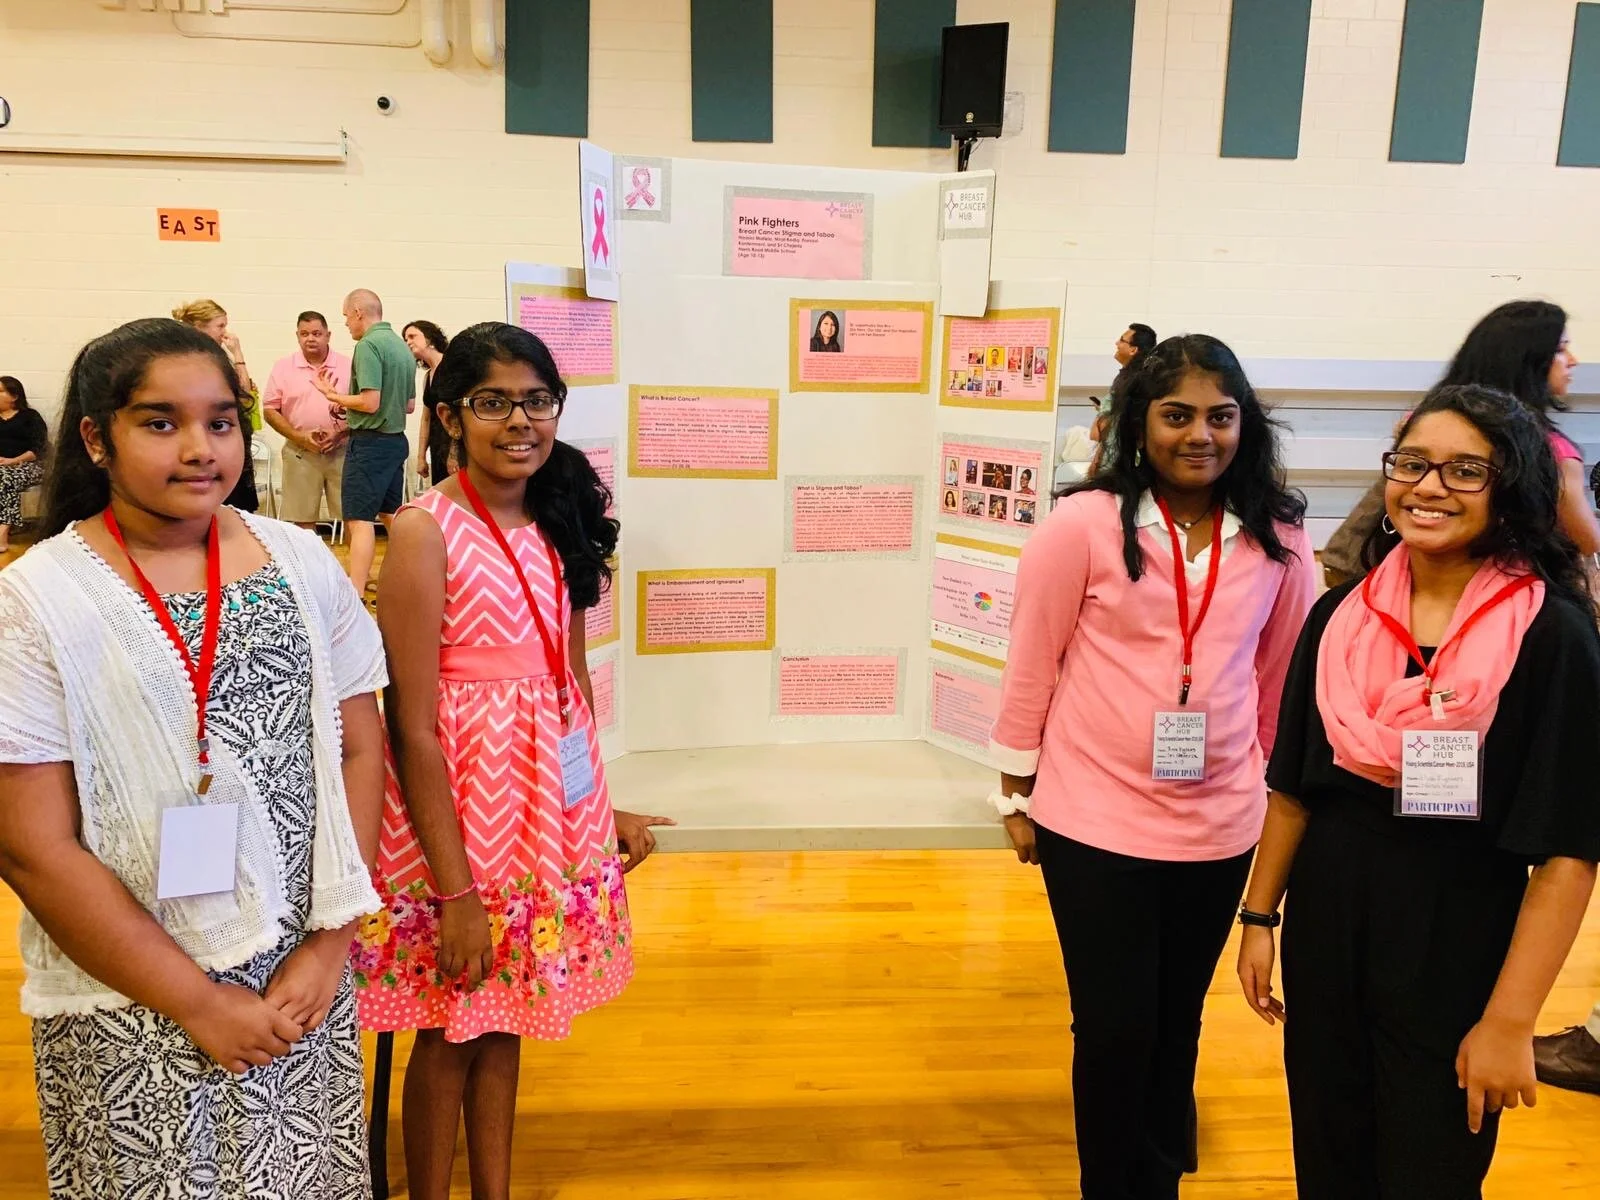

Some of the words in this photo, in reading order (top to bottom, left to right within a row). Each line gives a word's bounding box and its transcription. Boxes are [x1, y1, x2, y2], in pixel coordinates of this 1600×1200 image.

[960, 192, 985, 201] BREAST
[959, 202, 986, 211] CANCER
[959, 212, 973, 221] HUB
[159, 214, 217, 237] EAST
[738, 216, 759, 226] Pink
[762, 217, 800, 229] Fighters
[758, 228, 781, 236] Cancer
[782, 229, 803, 238] Stigma
[803, 230, 815, 238] and
[816, 231, 835, 239] Taboo
[1433, 744, 1473, 752] CANCER
[1433, 751, 1454, 759] HUB
[1157, 769, 1201, 777] PARTICIPANT
[1407, 801, 1472, 813] PARTICIPANT
